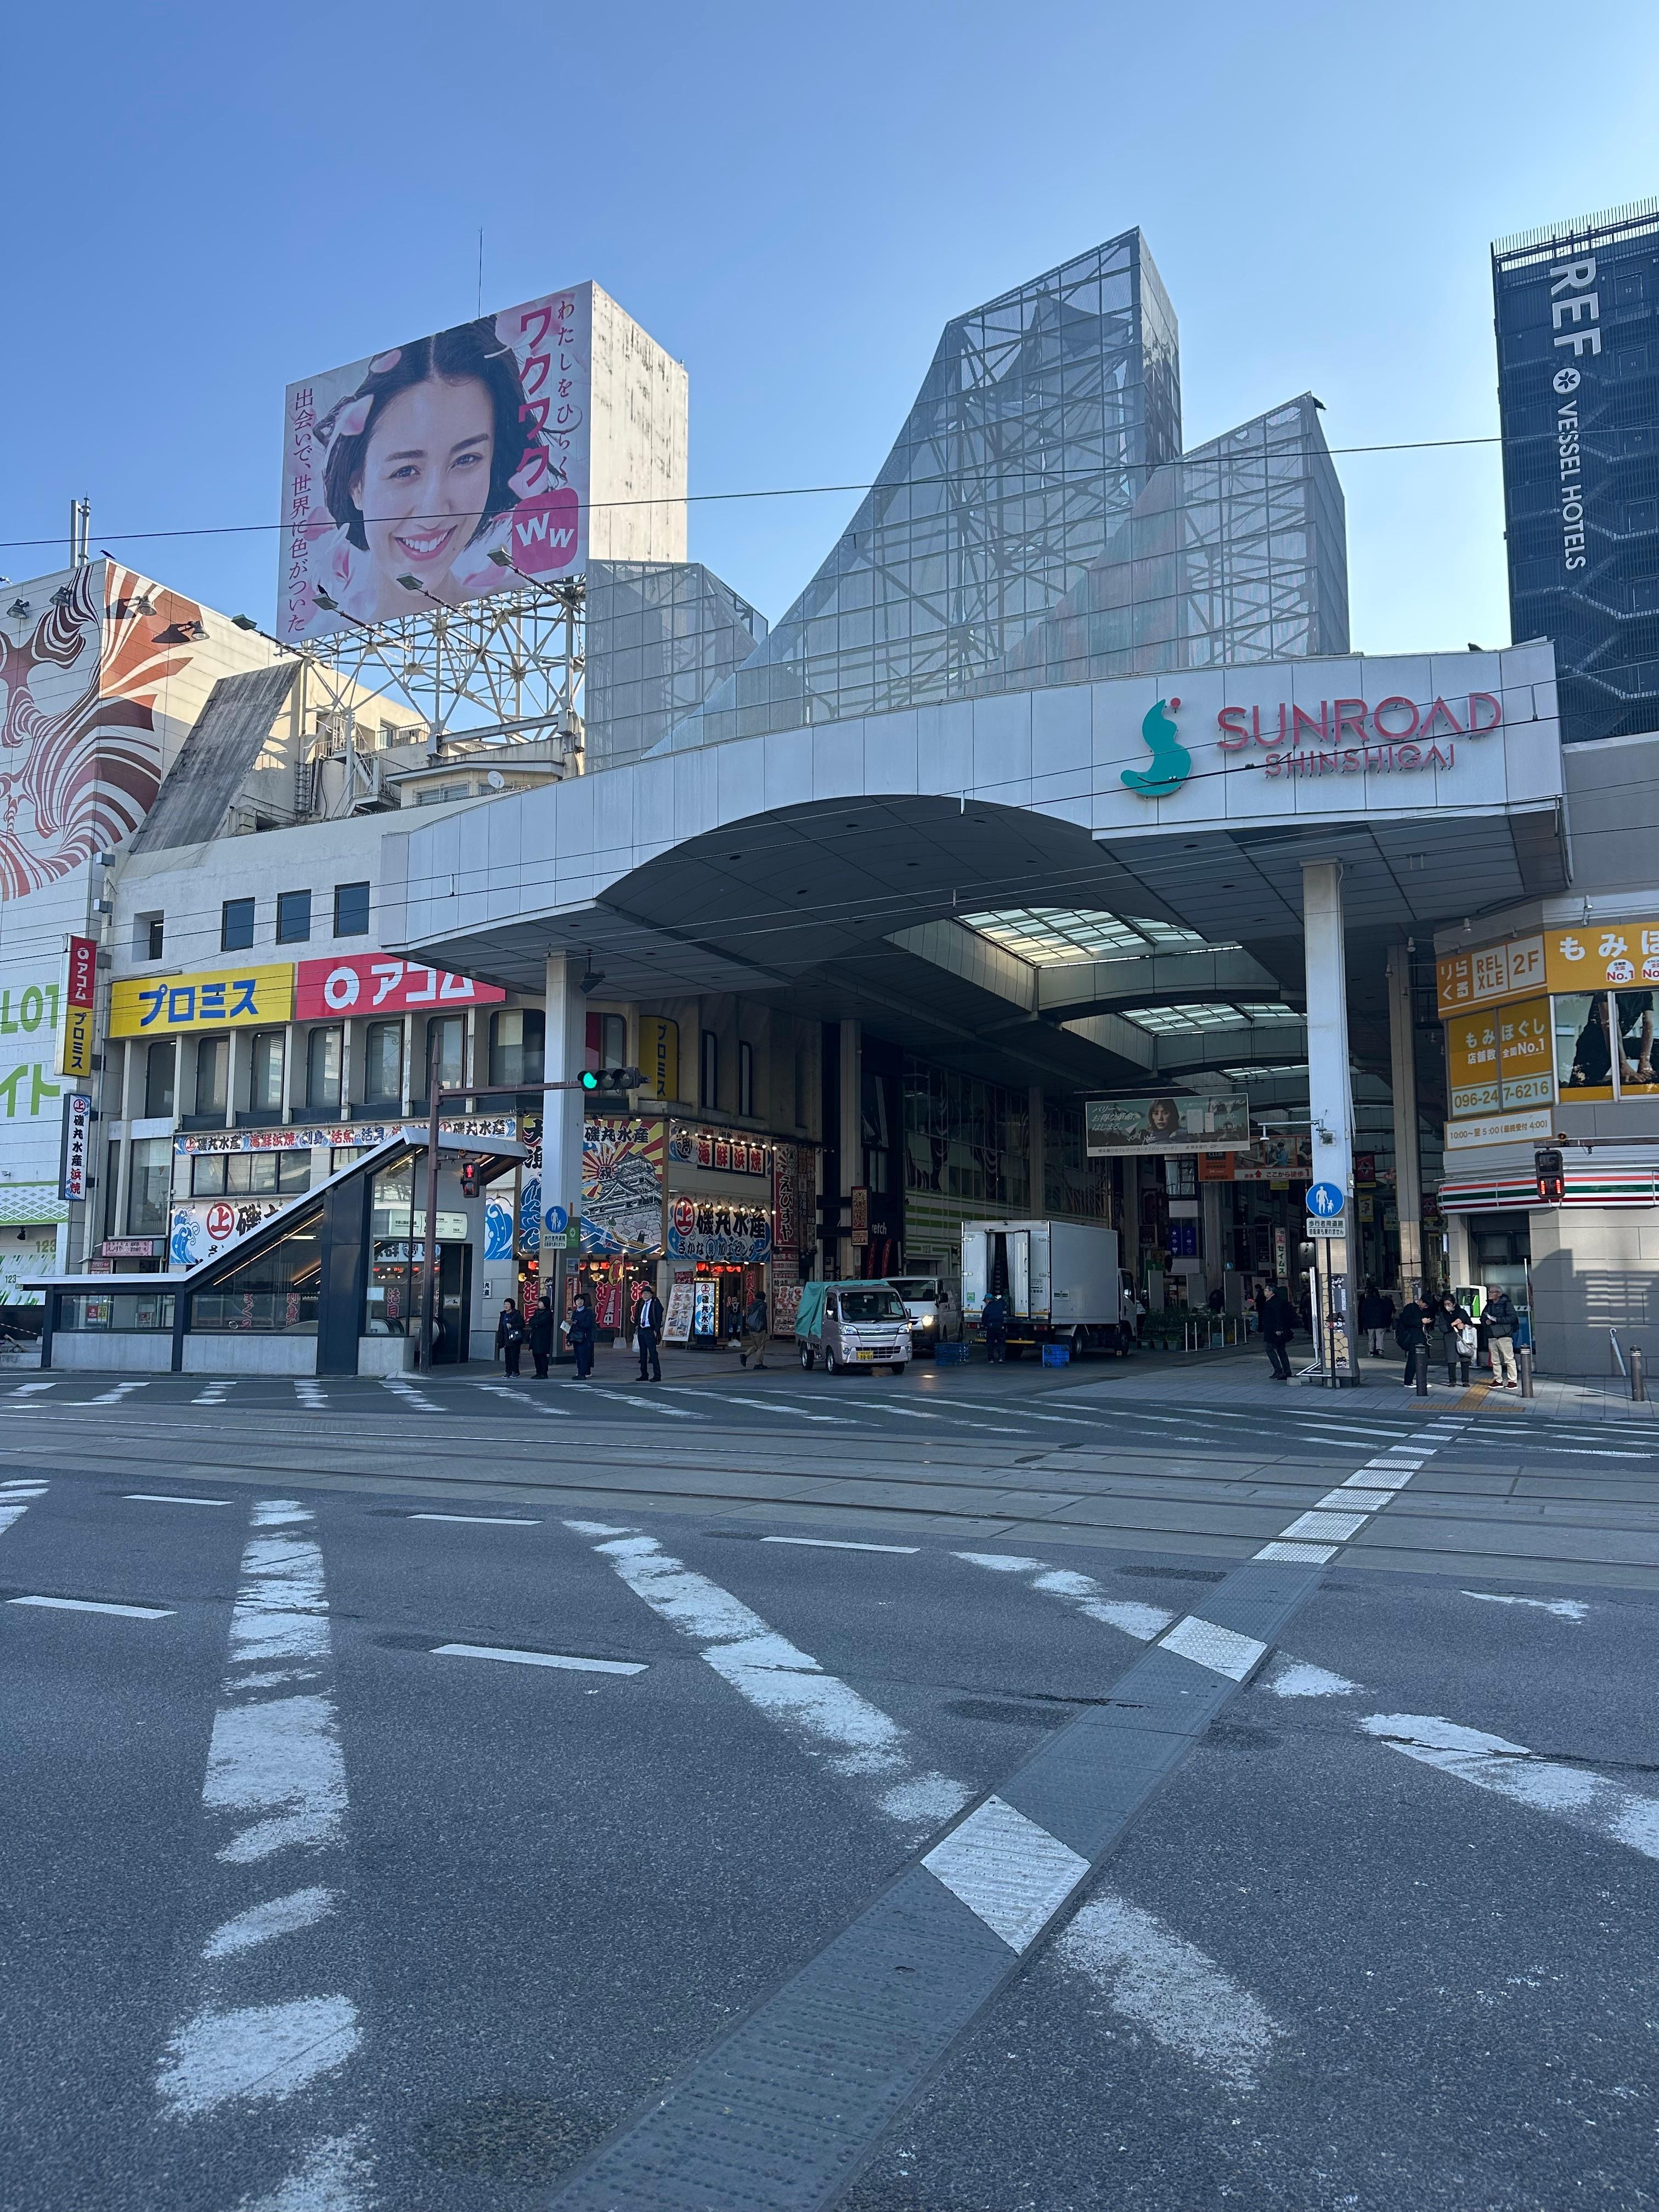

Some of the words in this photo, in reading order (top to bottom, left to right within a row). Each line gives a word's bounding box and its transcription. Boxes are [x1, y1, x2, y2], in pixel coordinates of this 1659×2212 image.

[1550, 257, 1602, 356] REF
[515, 306, 552, 487] ワクワク
[556, 300, 576, 480] わたしをひらく
[1558, 400, 1581, 481] VESSEL
[286, 387, 314, 634] 出会いで、世界に色がついた
[1561, 484, 1587, 571] HOTELS
[1217, 692, 1503, 752] SUNROAD
[1265, 743, 1455, 777] SHINSHIGAI
[1441, 960, 1468, 980] りら
[1476, 955, 1503, 974] REL
[1478, 970, 1504, 990] XLE
[1513, 950, 1539, 975] 2F
[1607, 970, 1634, 980] No.1
[76, 962, 88, 1000] アコム
[370, 962, 475, 1005] アコム
[1442, 980, 1469, 1000] くる
[139, 979, 258, 1027] プロミス
[71, 1013, 87, 1069] プロミス
[1465, 1018, 1545, 1048] もみほぐし
[657, 1024, 667, 1096] プロミス
[1468, 1048, 1496, 1065] 店舗数
[1454, 1081, 1549, 1108] 096-247-6216
[196, 1134, 242, 1152] 磯丸水産
[584, 1125, 650, 1144] 磯丸水産
[70, 1114, 85, 1195] 磯丸水産浜焼
[698, 1142, 761, 1172] 海鮮浜焼
[600, 1166, 613, 1180] 祝
[696, 1203, 766, 1239] 磯丸水産
[779, 1175, 794, 1242] えびすや
[5, 1274, 16, 1284] 123
[701, 1295, 710, 1333] 磯丸水産
